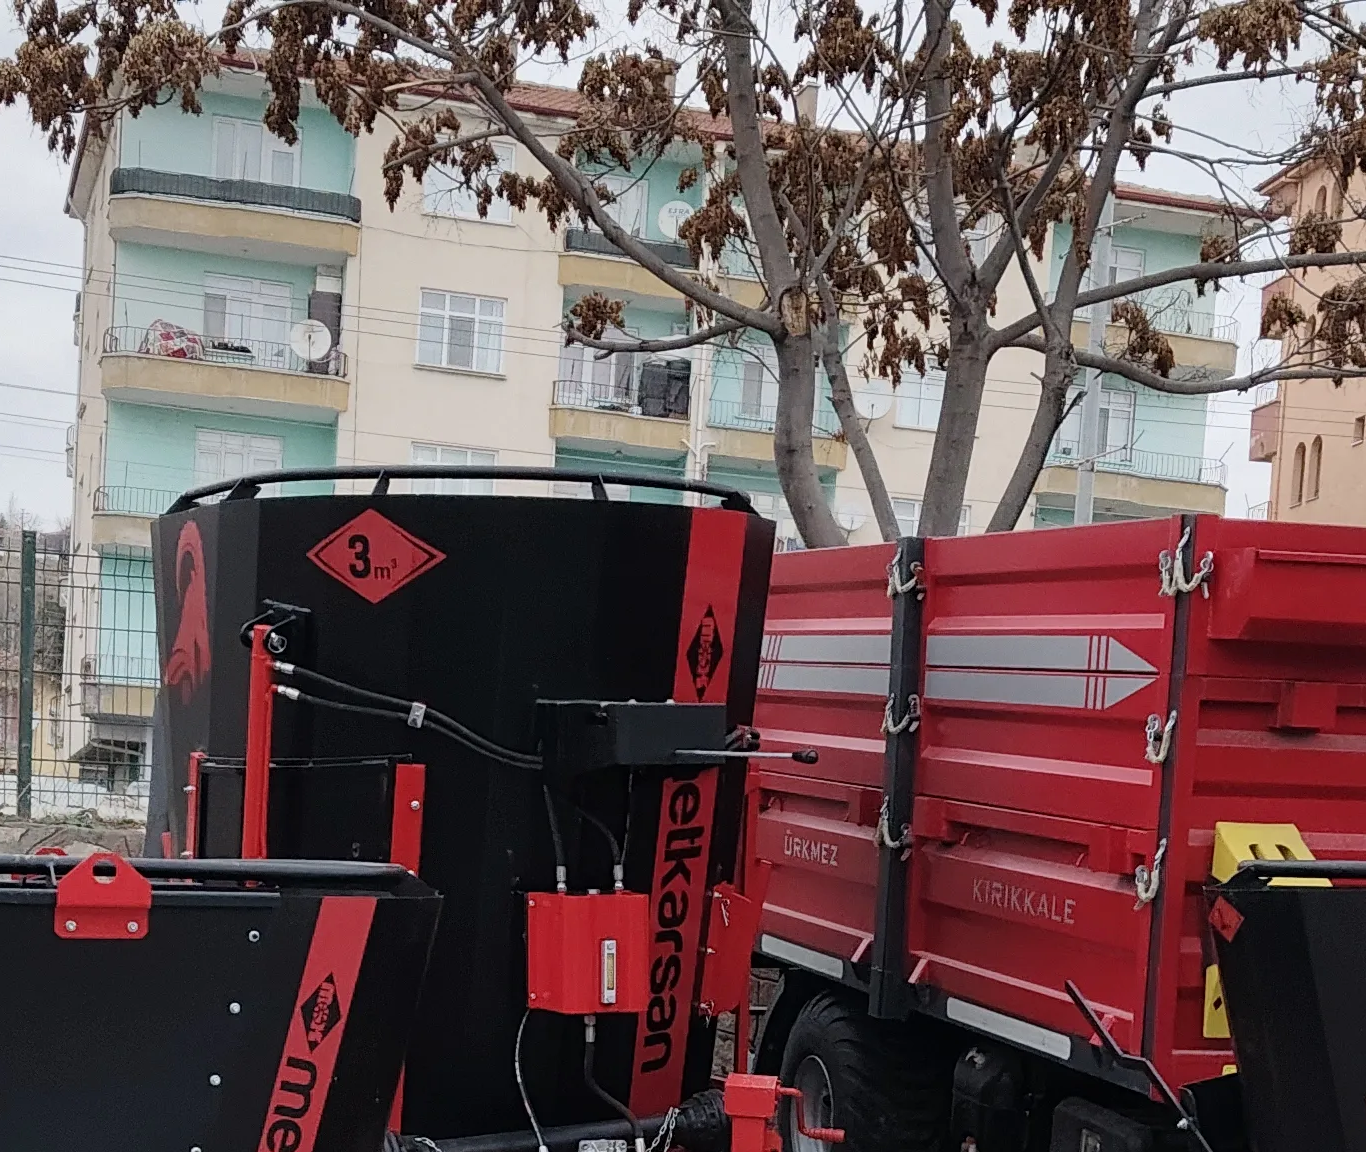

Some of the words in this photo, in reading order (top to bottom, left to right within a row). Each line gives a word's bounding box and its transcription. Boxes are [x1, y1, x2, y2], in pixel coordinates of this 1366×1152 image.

[348, 534, 370, 579] 3
[784, 829, 839, 867] ÜRKMEZ
[640, 767, 706, 1075] etkarsan
